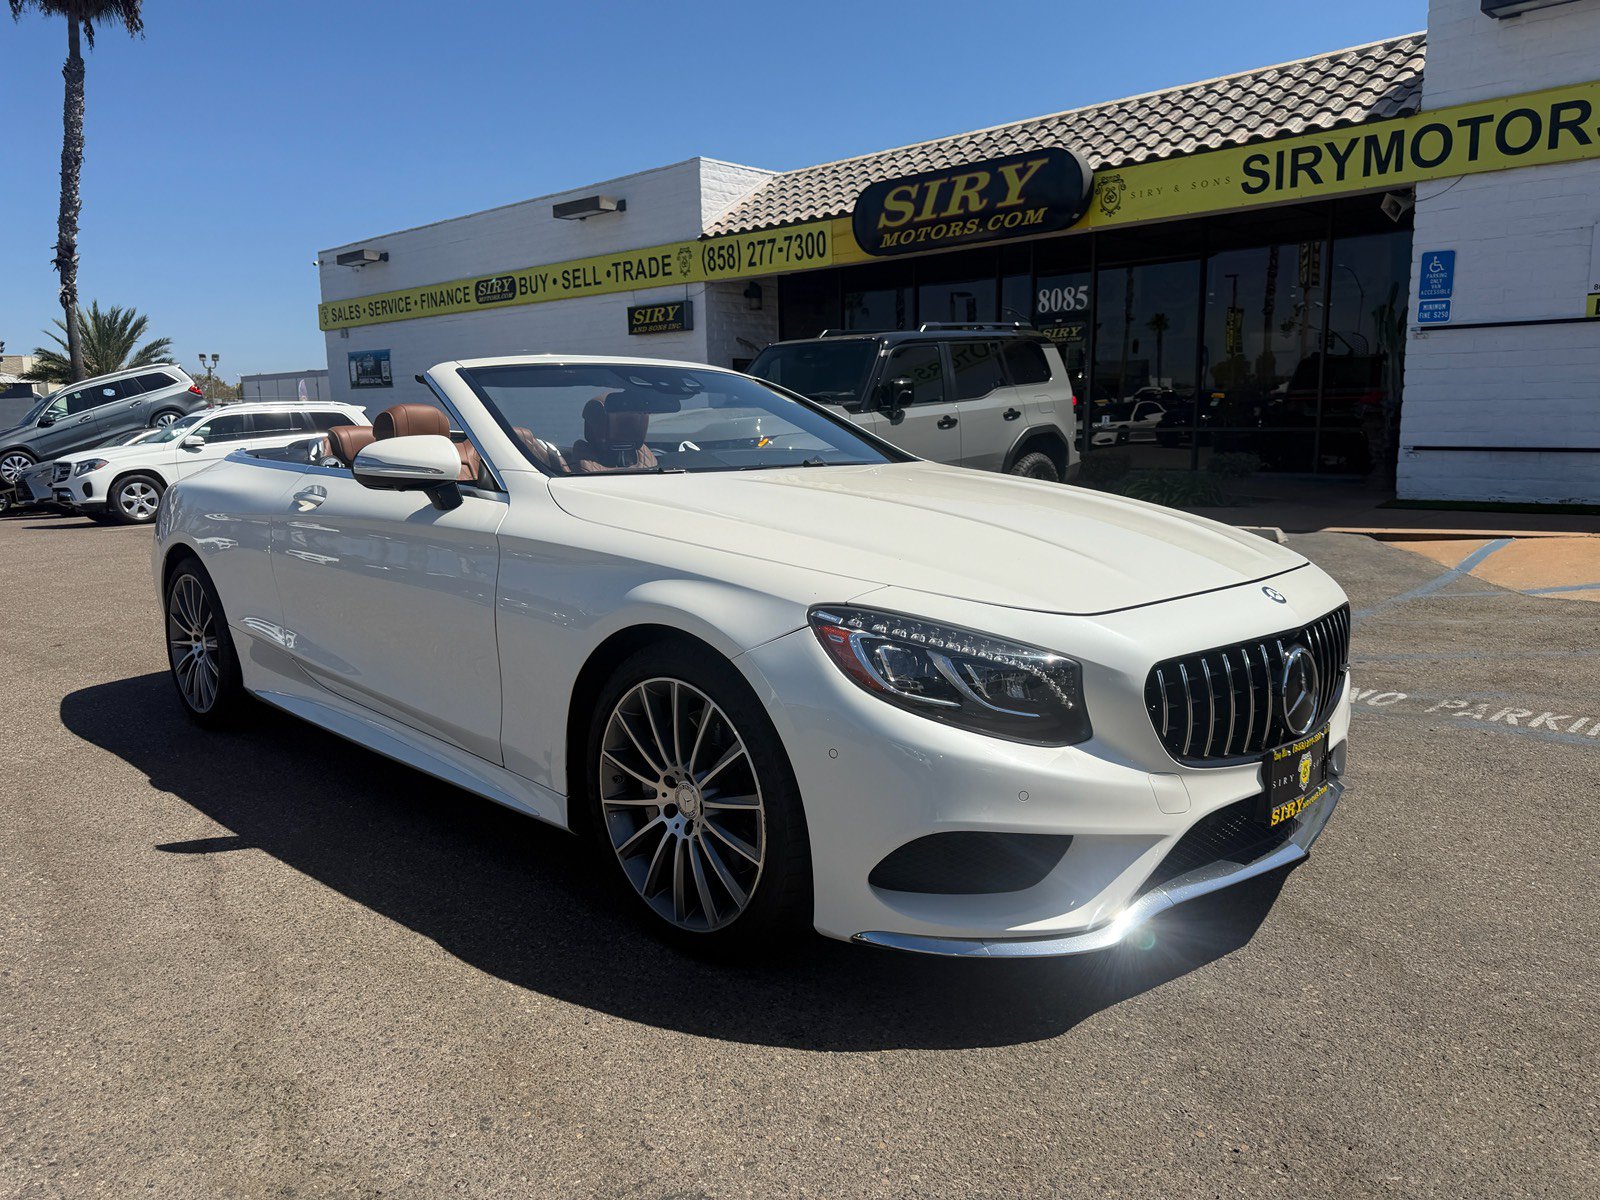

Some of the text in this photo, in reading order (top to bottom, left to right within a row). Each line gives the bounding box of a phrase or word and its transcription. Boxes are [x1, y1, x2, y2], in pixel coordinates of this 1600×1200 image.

[1240, 99, 1600, 194] SIRYMOTOR
[877, 157, 1050, 229] SIRY
[1130, 176, 1232, 199] SIRY & SONS
[880, 207, 1048, 248] MOTORS.COM
[702, 230, 826, 276] (858) 277-7300
[479, 279, 513, 296] SIRY
[519, 254, 672, 296] BUY SELL TRADE
[331, 286, 471, 322] SALES SERVICE FINANCE
[633, 305, 680, 325] SIRY
[1038, 285, 1089, 313] 8085
[1424, 699, 1600, 736] PARKI
[1272, 774, 1295, 789] SIRY
